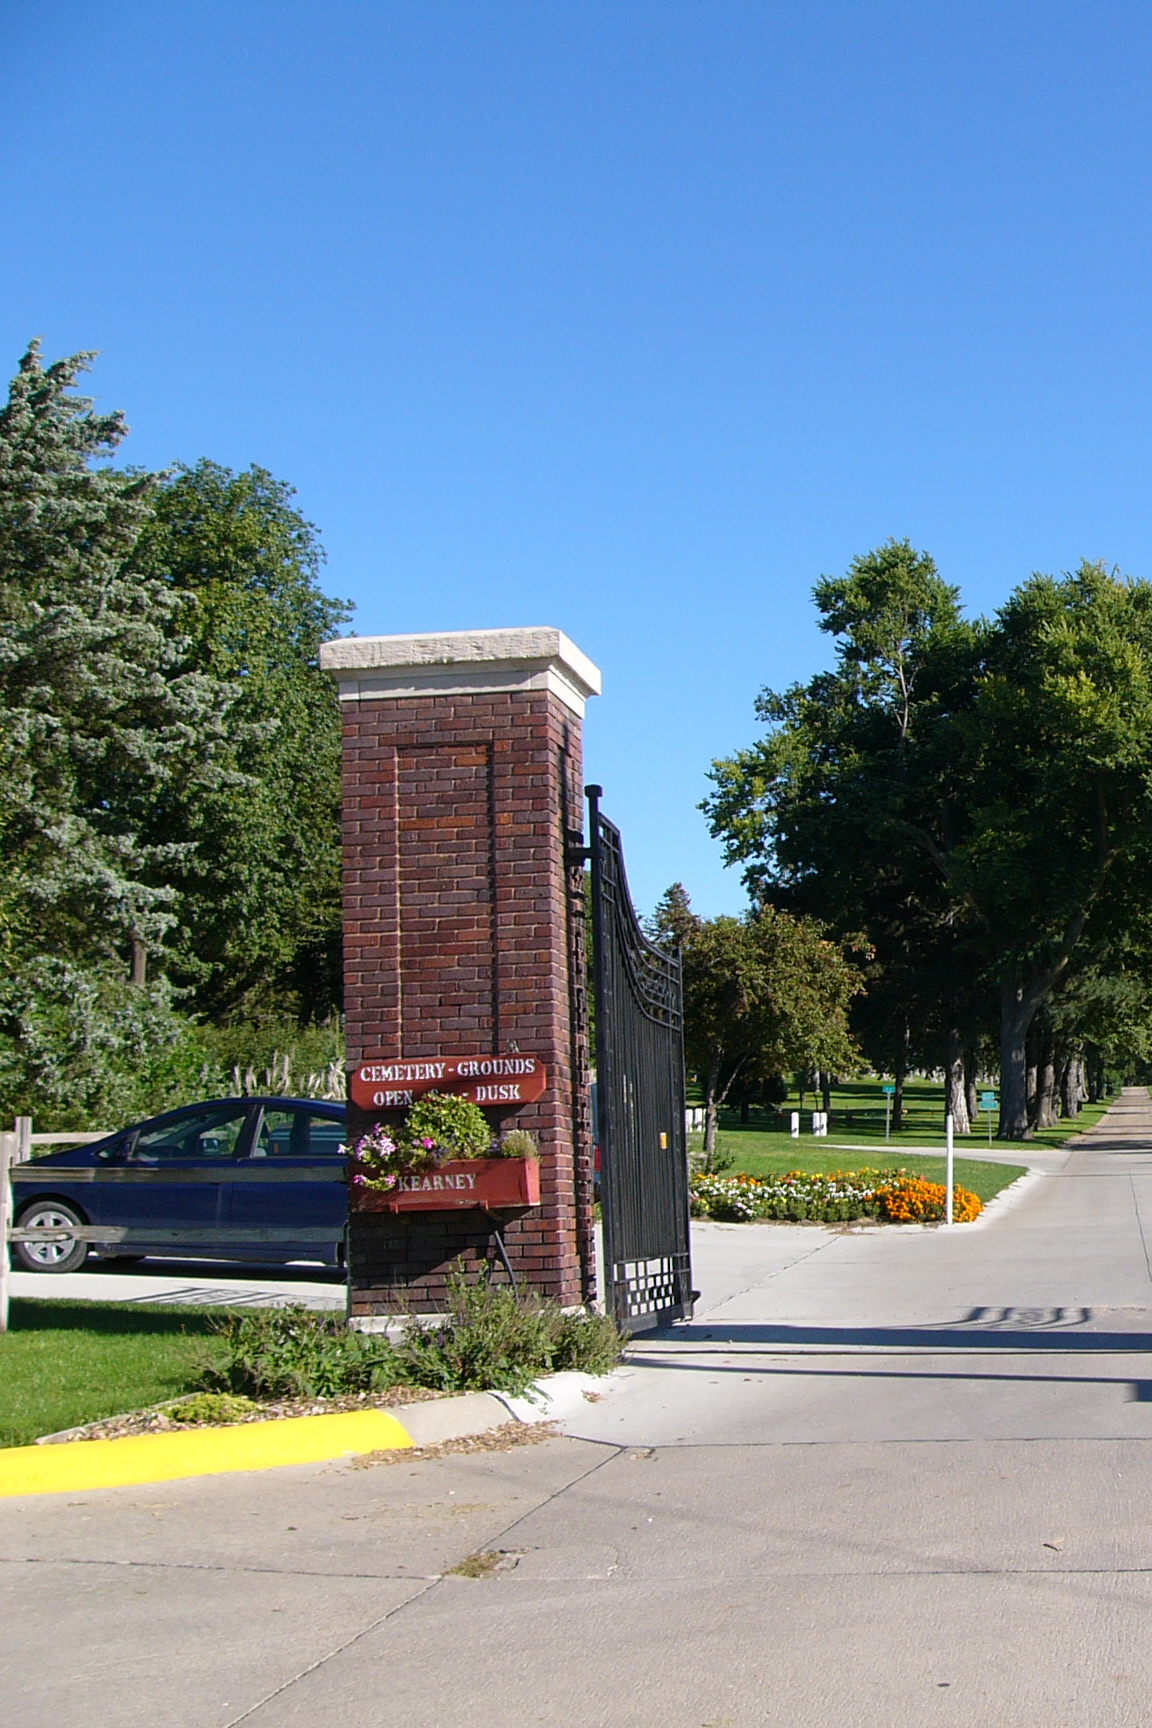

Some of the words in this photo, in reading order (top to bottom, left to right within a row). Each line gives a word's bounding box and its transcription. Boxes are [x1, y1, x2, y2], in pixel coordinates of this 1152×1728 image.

[360, 1062, 446, 1083] CEMETERY
[457, 1058, 536, 1077] GROUNDS
[373, 1089, 414, 1106] OPEN
[476, 1084, 521, 1101] DUSK
[398, 1173, 477, 1192] KEARNEY
